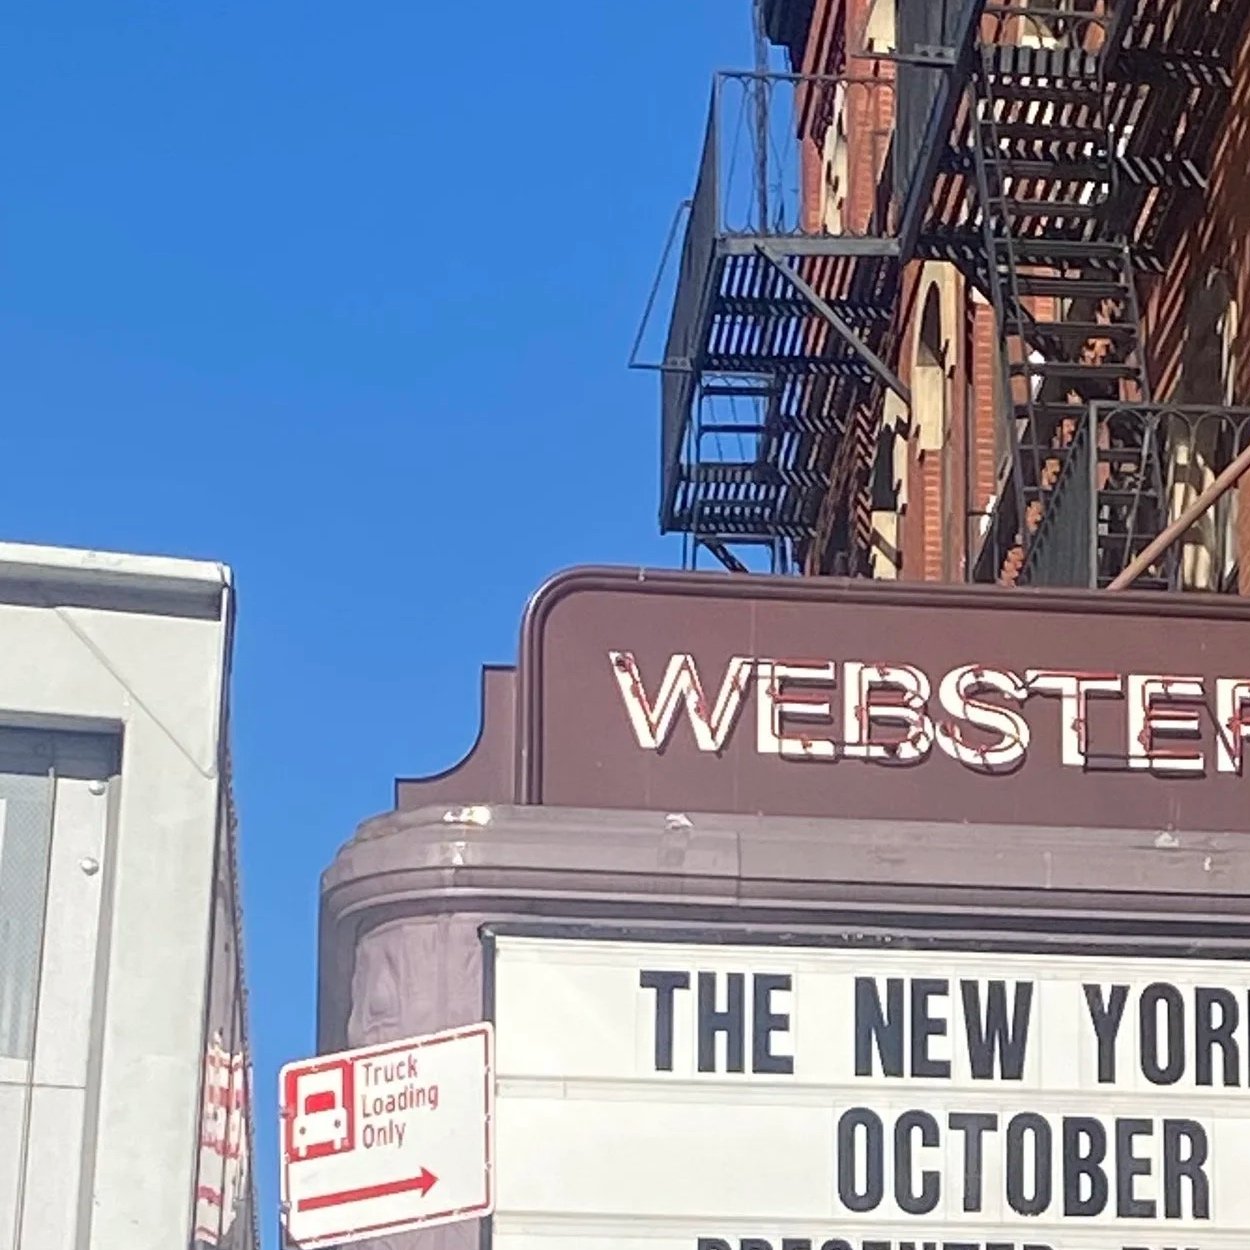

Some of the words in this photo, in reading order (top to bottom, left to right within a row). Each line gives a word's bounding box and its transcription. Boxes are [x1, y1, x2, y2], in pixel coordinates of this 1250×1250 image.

[640, 969, 794, 1074] THE
[854, 976, 1034, 1080] NEW
[362, 1054, 418, 1086] Truck
[361, 1084, 439, 1118] Loading
[362, 1118, 407, 1150] Only
[837, 1106, 1210, 1219] OCTOBER
